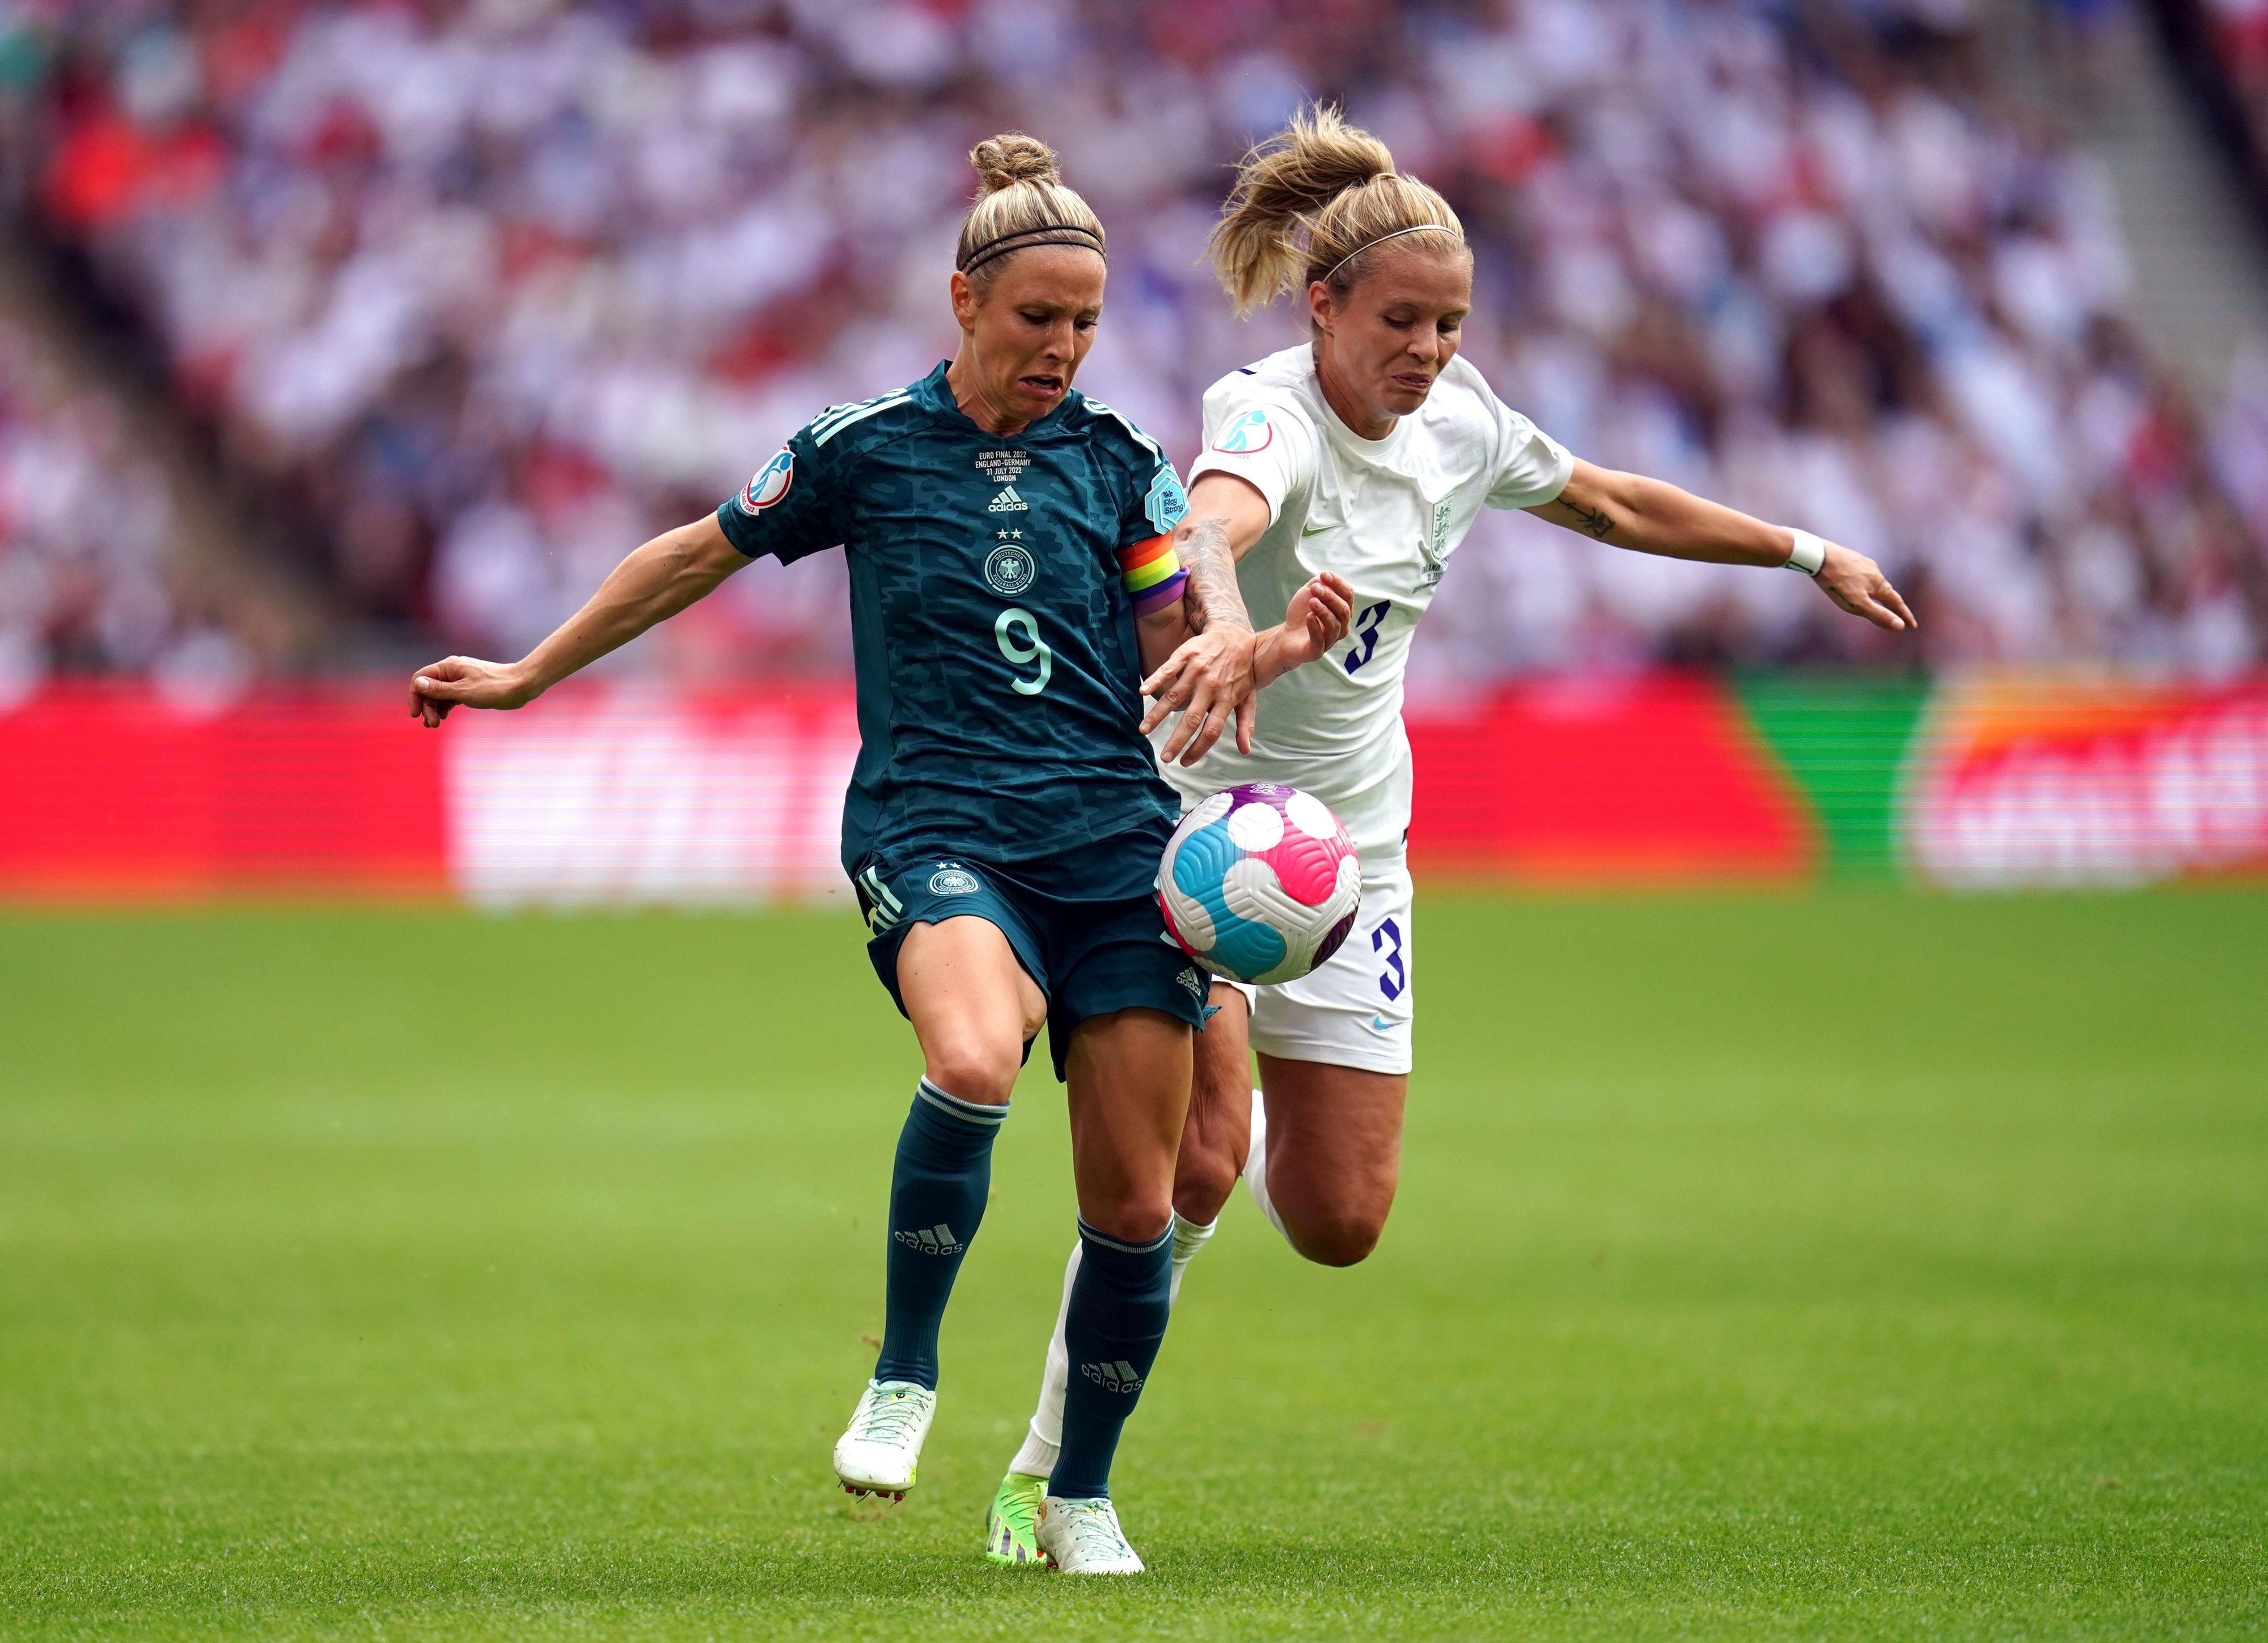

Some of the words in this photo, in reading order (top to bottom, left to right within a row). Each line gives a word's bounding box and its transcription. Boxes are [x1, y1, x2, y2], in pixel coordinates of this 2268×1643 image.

[975, 459, 1031, 468] ENGLAND-GERMANY
[744, 503, 755, 513] 2022
[988, 502, 1029, 512] adidas
[1165, 504, 1183, 514] Strong
[995, 551, 1024, 561] DEUTSCHER
[1344, 599, 1391, 675] 3
[995, 608, 1051, 695] 9
[1372, 917, 1404, 1002] 3
[1176, 976, 1201, 996] adidas
[895, 1231, 963, 1255] adidas
[1081, 1365, 1143, 1394] adidas
